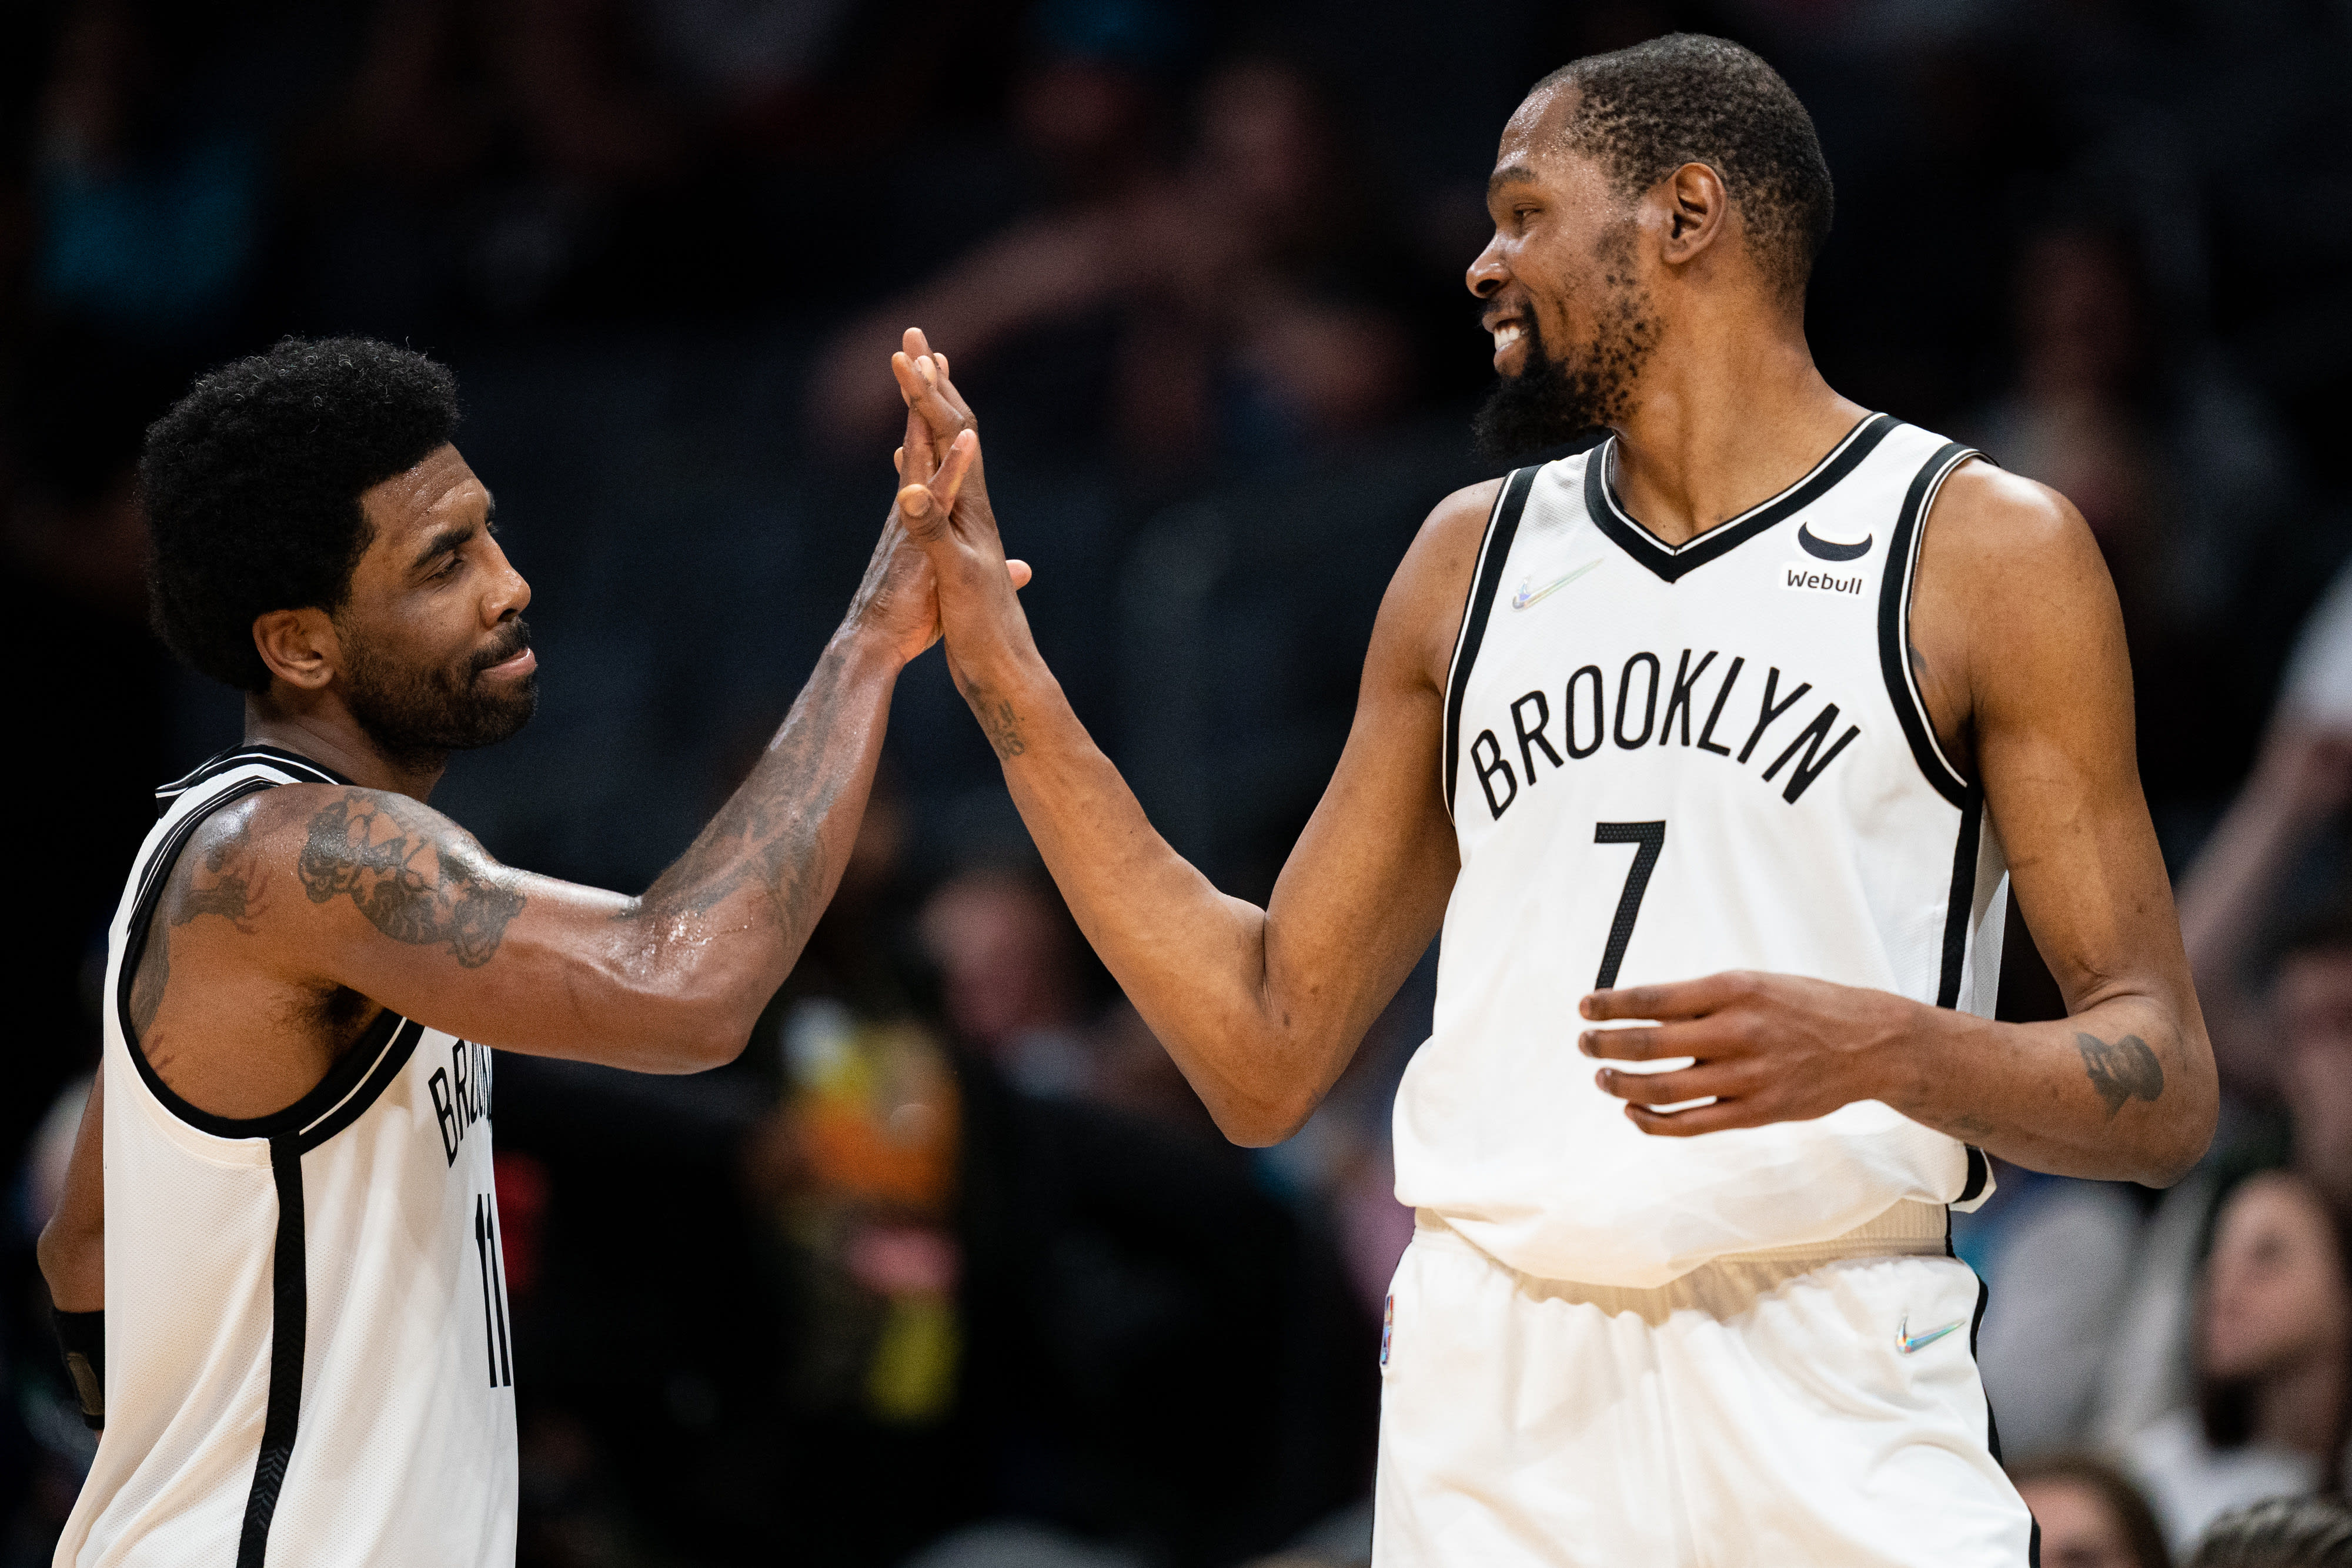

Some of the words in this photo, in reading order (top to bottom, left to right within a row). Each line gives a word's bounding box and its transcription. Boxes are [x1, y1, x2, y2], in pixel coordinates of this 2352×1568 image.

[1788, 569, 1862, 594] Webull
[1471, 648, 1860, 820] BROOKLYN
[1594, 820, 1666, 991] 7
[475, 1193, 512, 1388] 11
